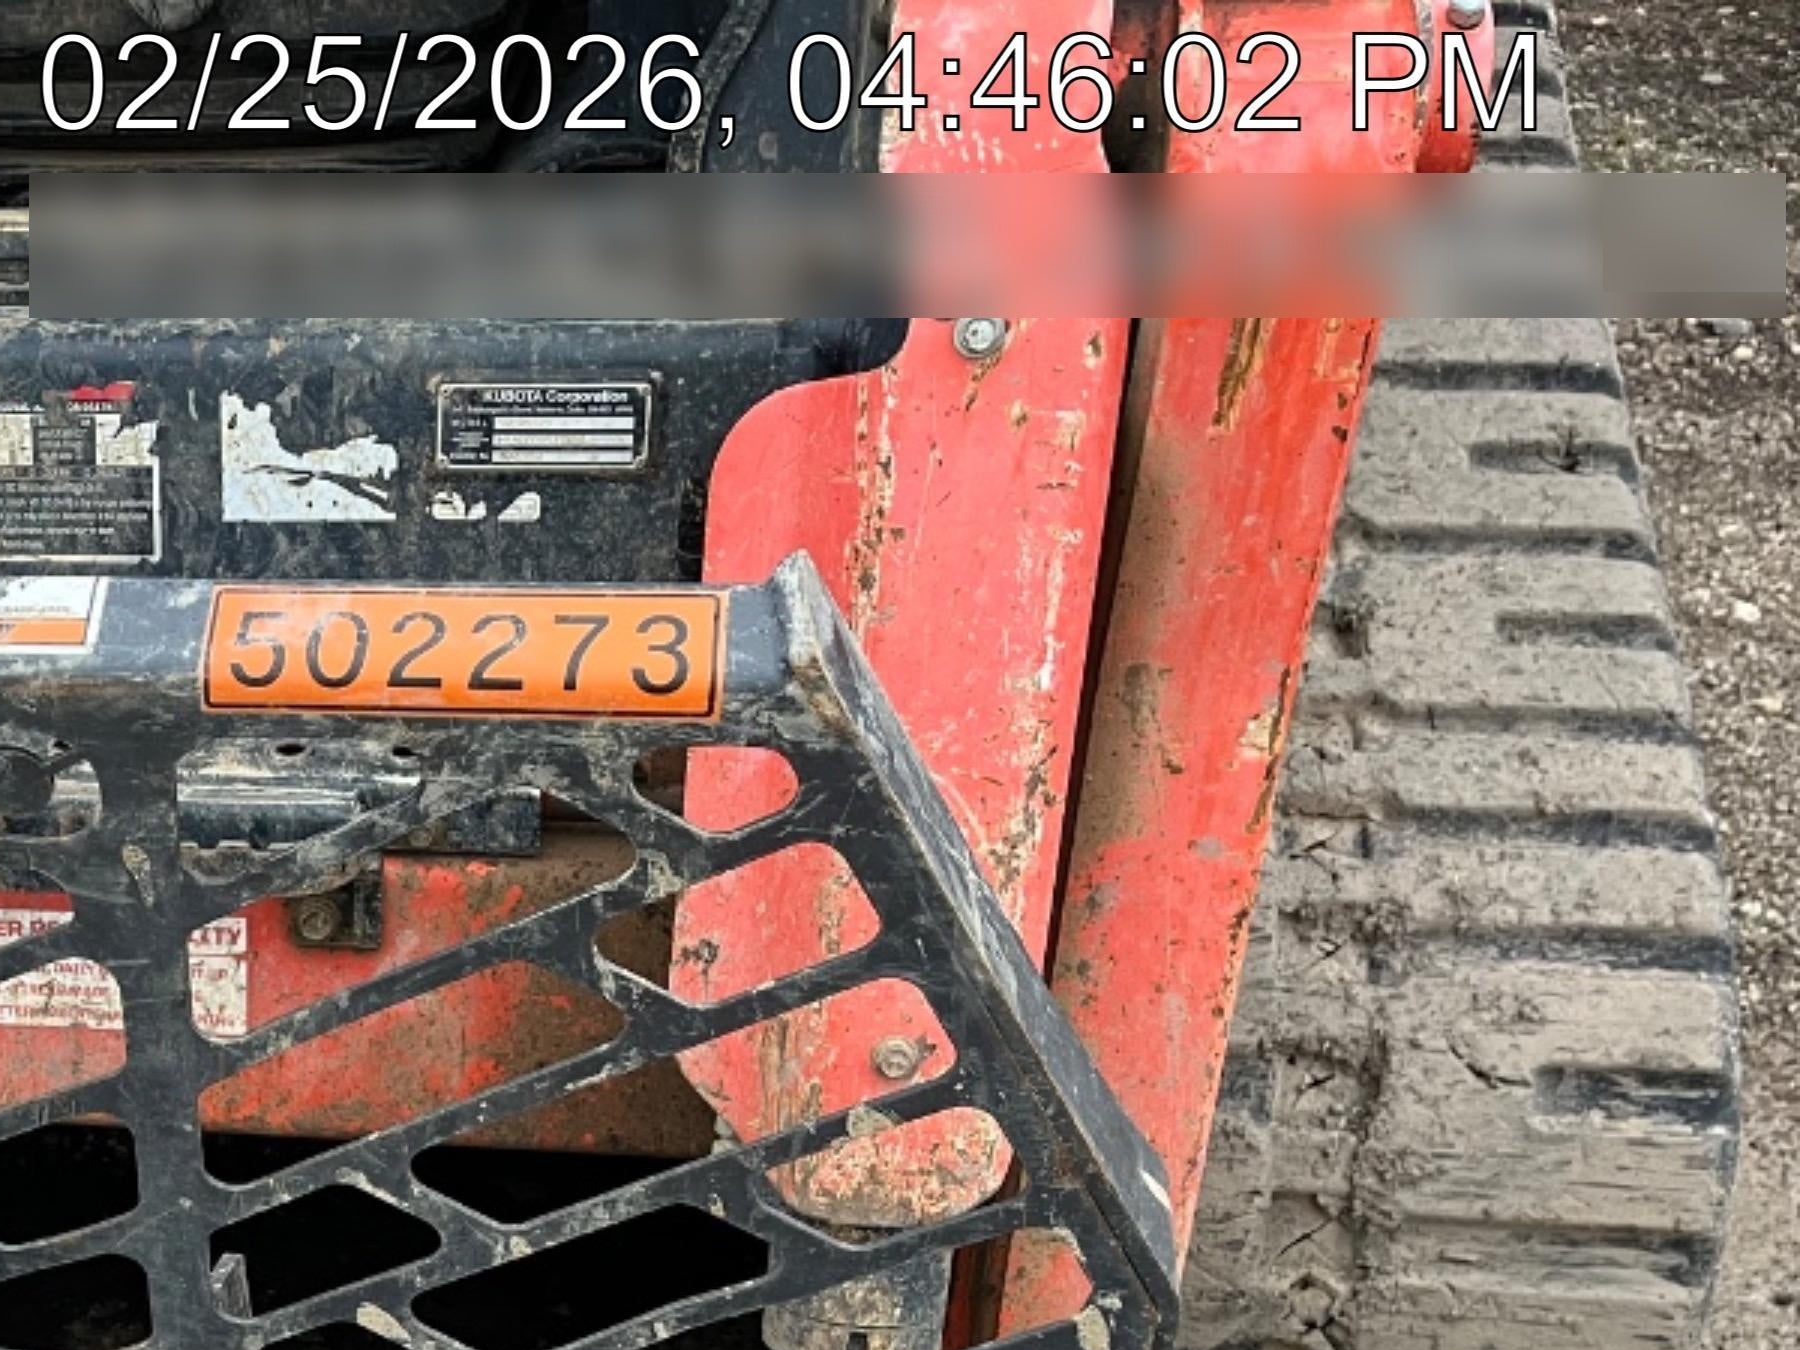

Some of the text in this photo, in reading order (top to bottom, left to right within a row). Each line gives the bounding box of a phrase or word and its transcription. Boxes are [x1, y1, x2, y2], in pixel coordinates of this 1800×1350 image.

[483, 389, 629, 405] KUBOTA Corporation
[230, 610, 689, 695] 502273
